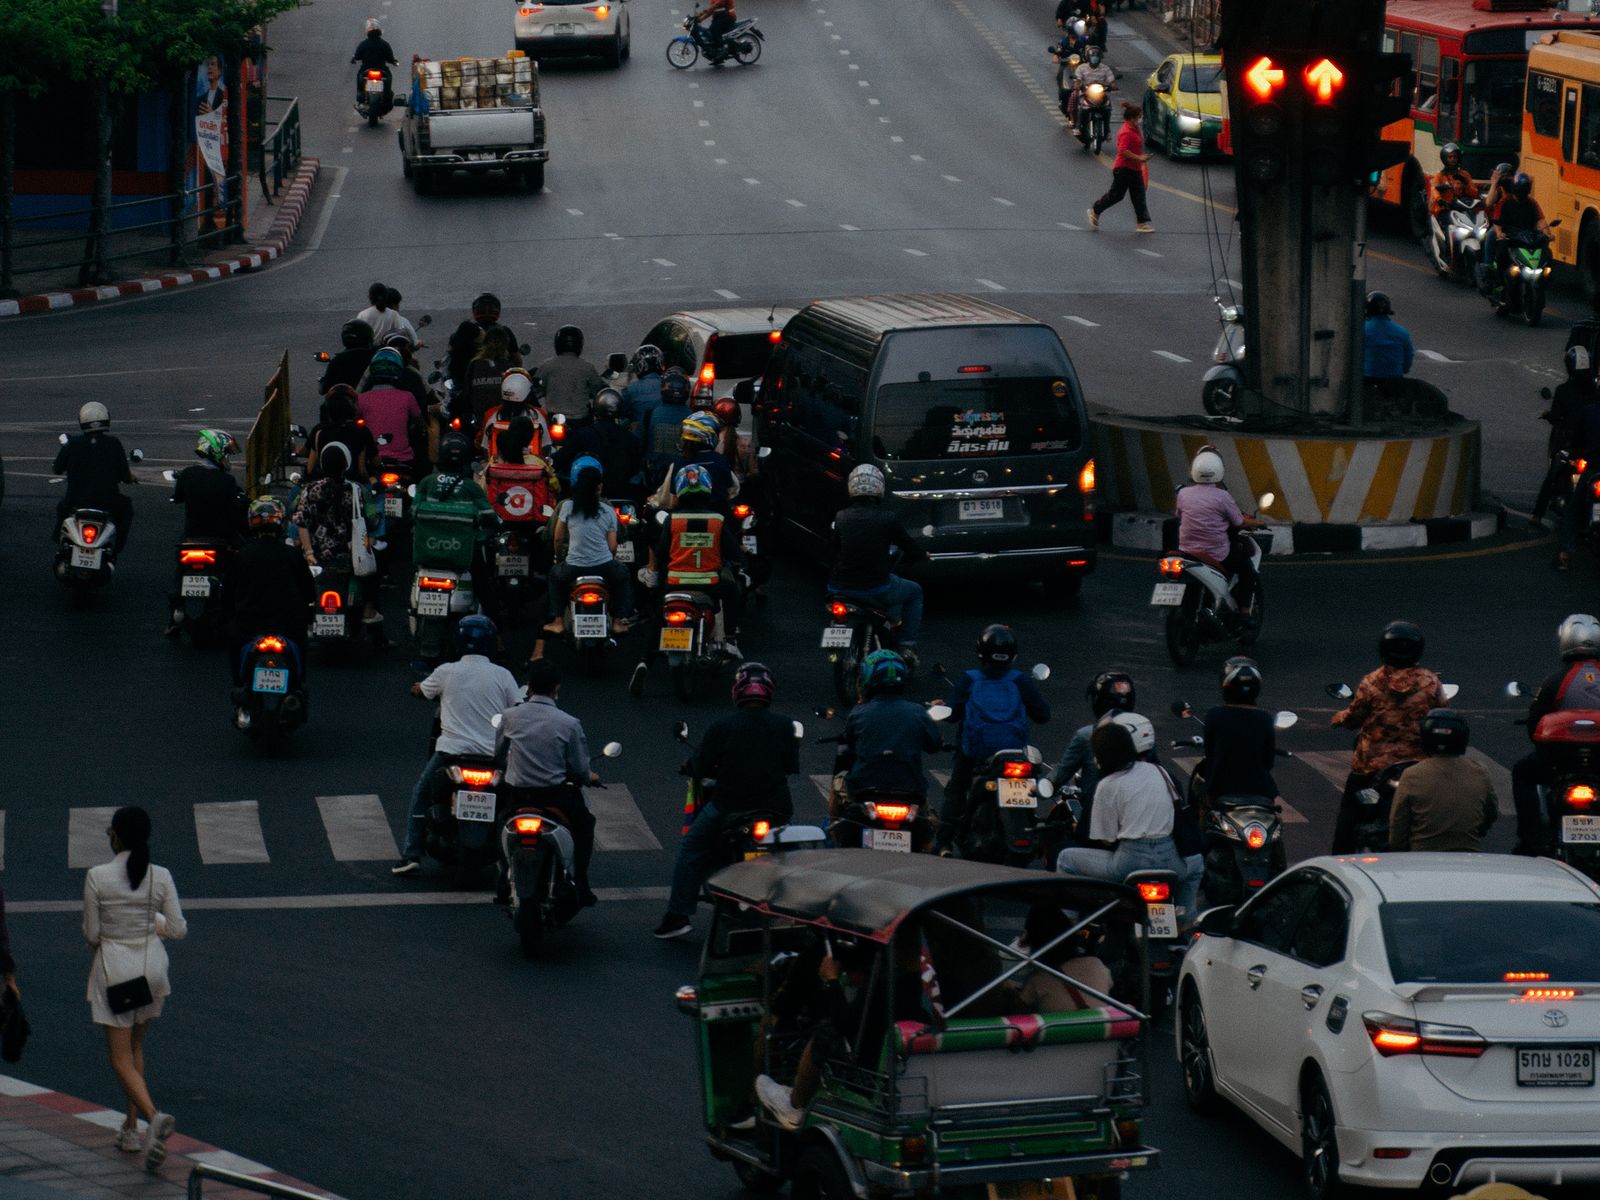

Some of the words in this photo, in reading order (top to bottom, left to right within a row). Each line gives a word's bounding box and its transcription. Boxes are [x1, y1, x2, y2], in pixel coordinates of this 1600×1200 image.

[1357, 243, 1367, 257] 7
[426, 537, 462, 550] Grab
[692, 550, 701, 569] 1
[1556, 1052, 1591, 1068] 1028
